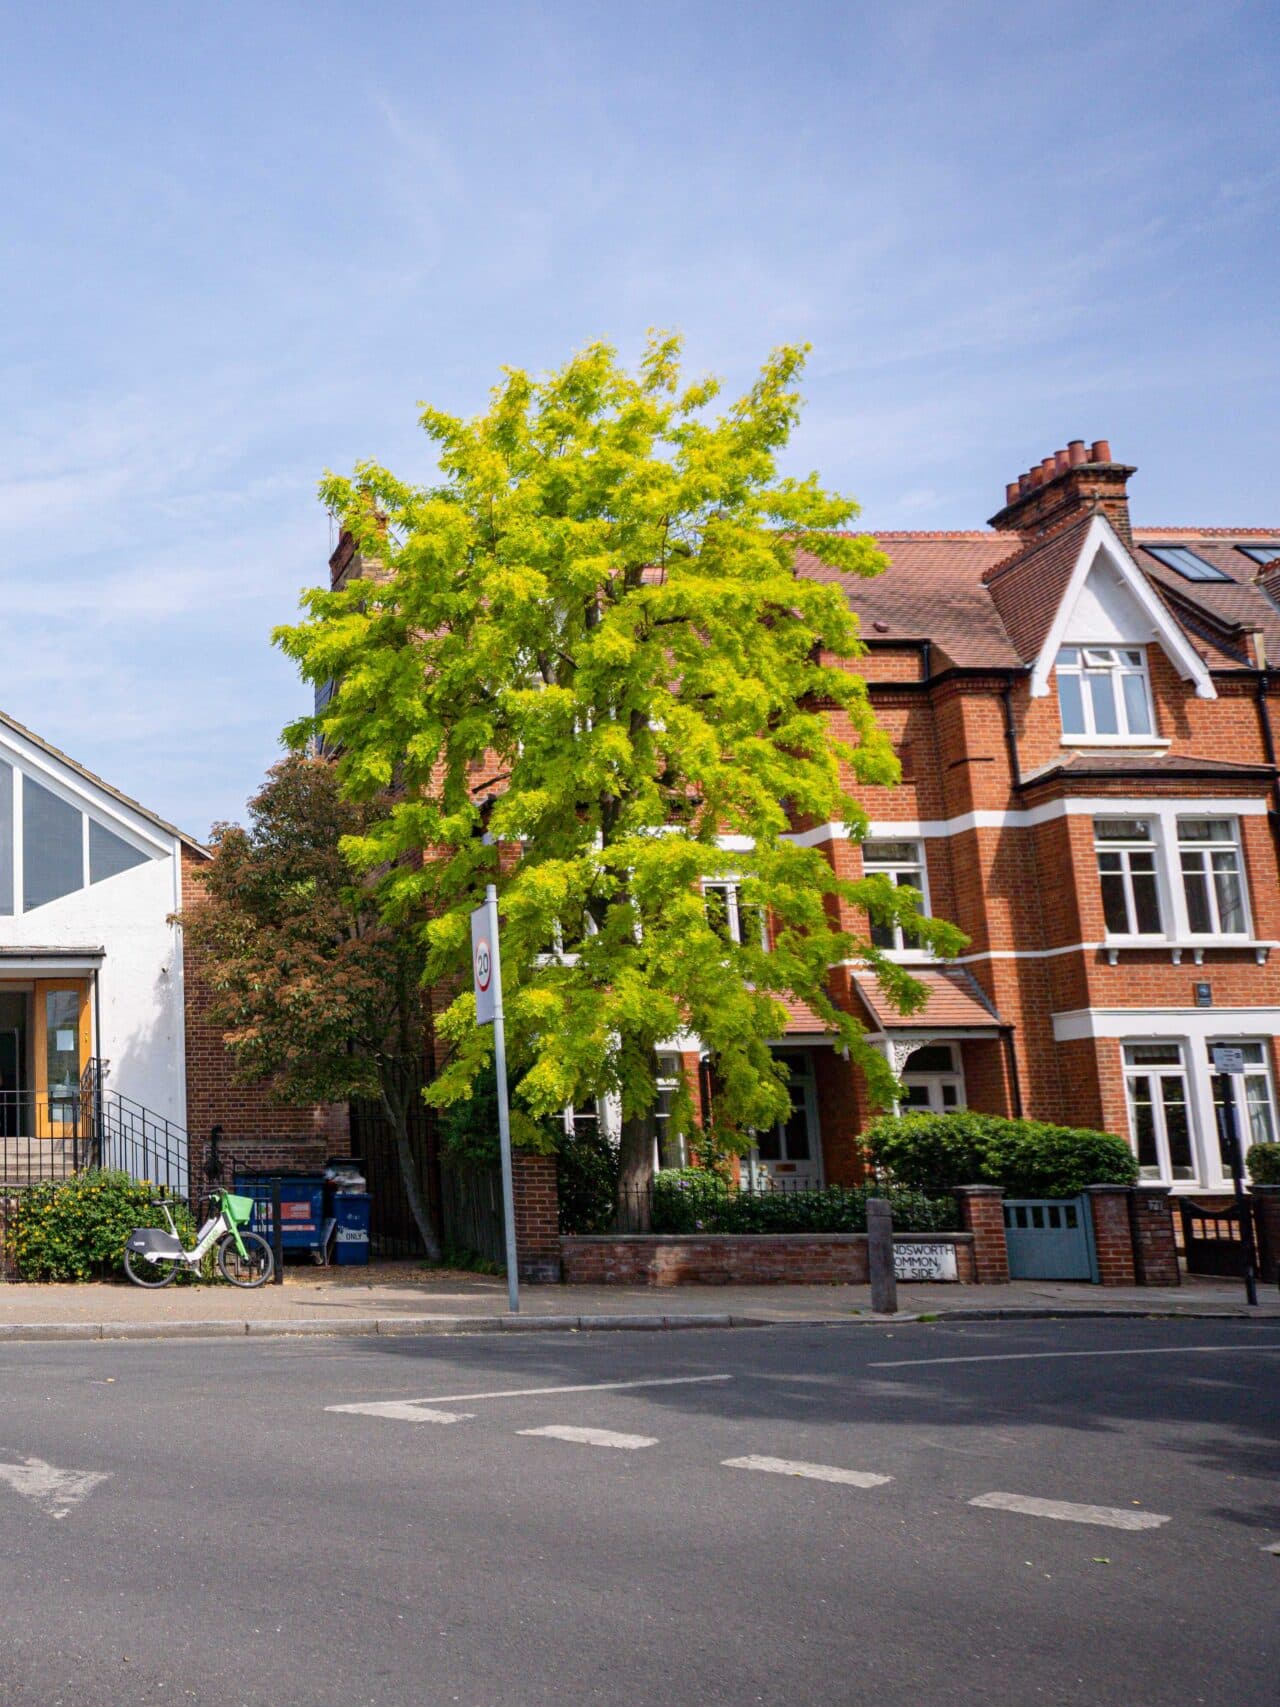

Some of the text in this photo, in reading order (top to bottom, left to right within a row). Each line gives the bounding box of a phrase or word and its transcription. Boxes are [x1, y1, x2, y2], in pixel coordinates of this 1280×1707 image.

[478, 952, 488, 977] 20
[893, 1245, 955, 1255] NDSWORTH
[895, 1257, 938, 1267] OMMON
[911, 1268, 935, 1279] SIDE
